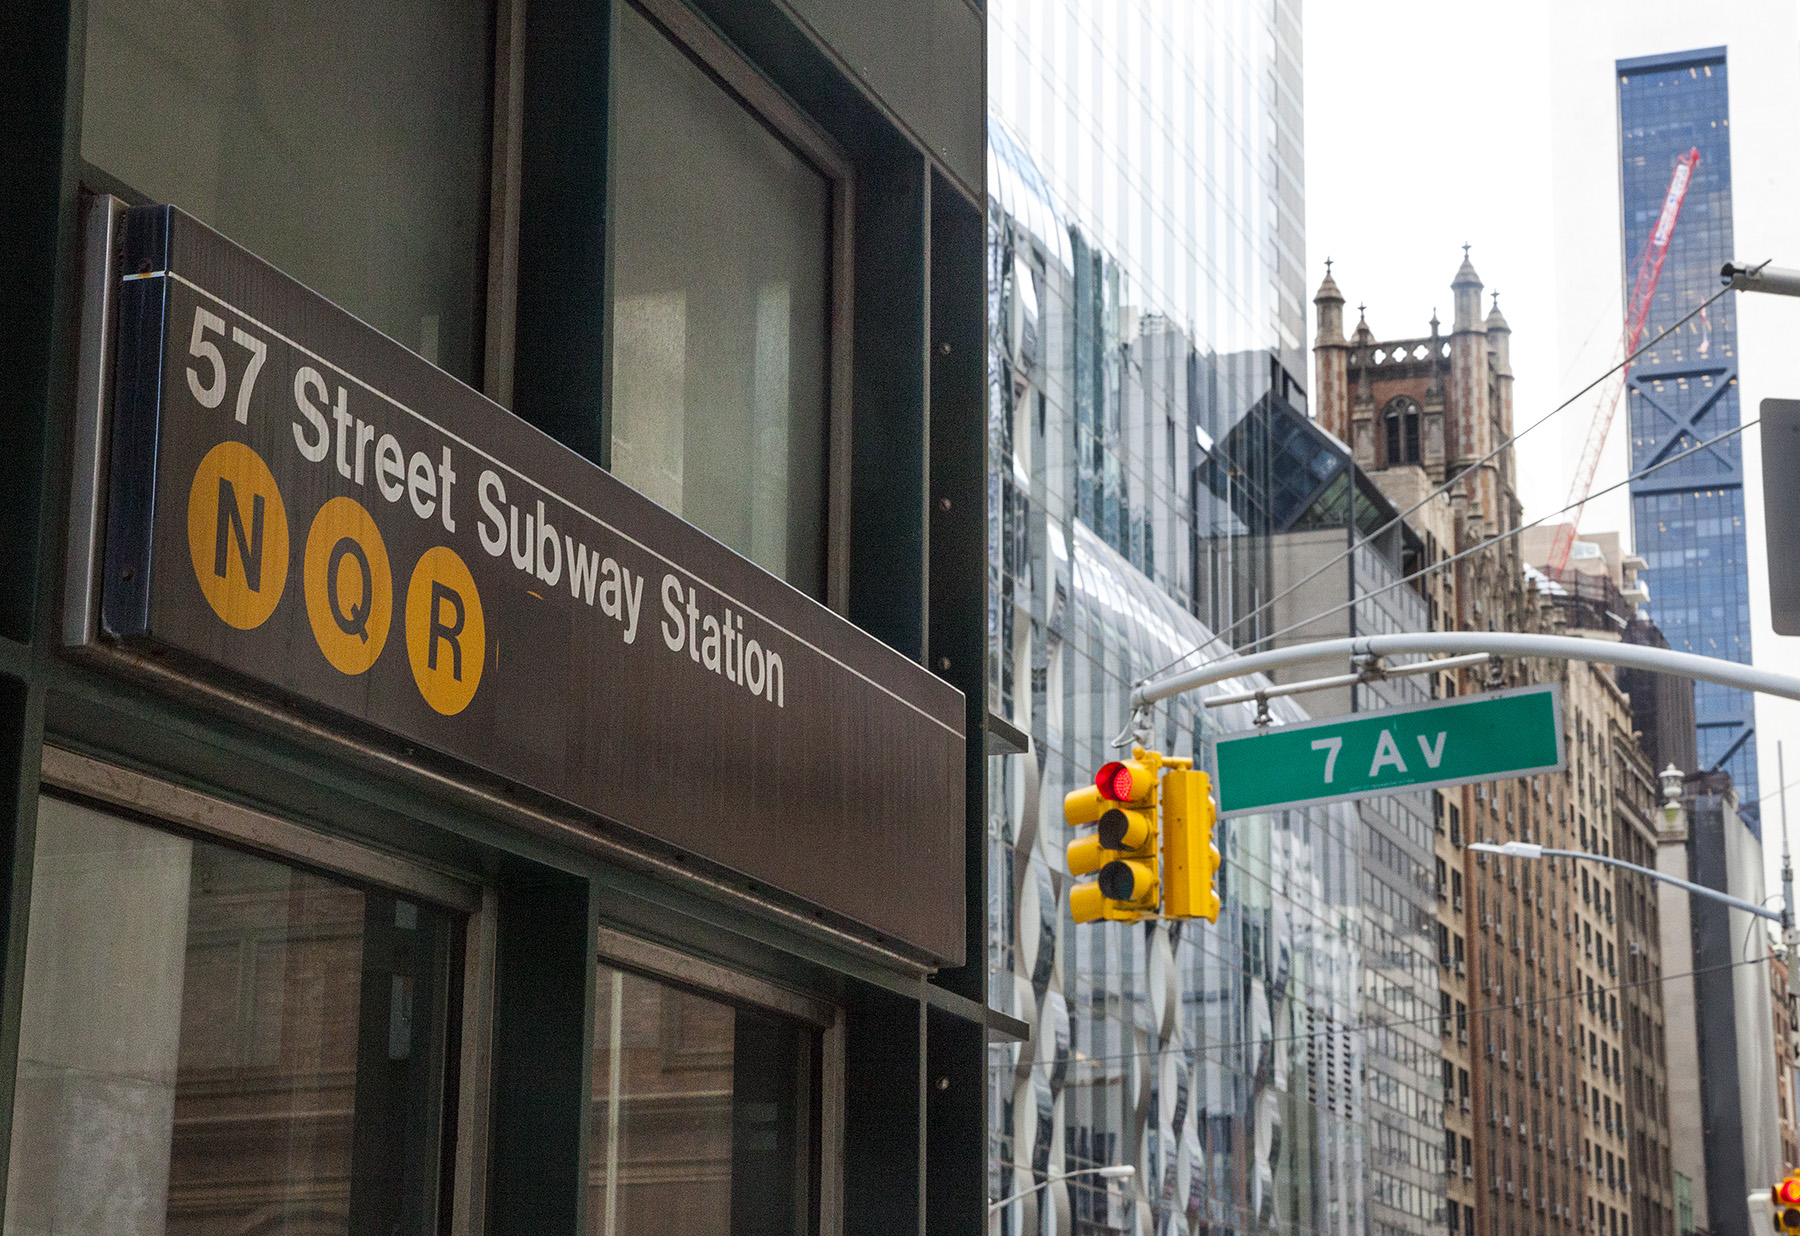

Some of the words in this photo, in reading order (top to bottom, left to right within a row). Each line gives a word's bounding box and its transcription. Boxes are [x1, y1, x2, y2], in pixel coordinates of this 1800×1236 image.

[186, 306, 267, 425] 57
[292, 366, 456, 534] Street
[478, 470, 644, 645] Subway
[661, 573, 784, 708] Station
[214, 476, 265, 594] N
[327, 536, 373, 645] Q
[428, 579, 466, 682] R
[1311, 736, 1343, 784] 7
[1369, 729, 1447, 777] Av
